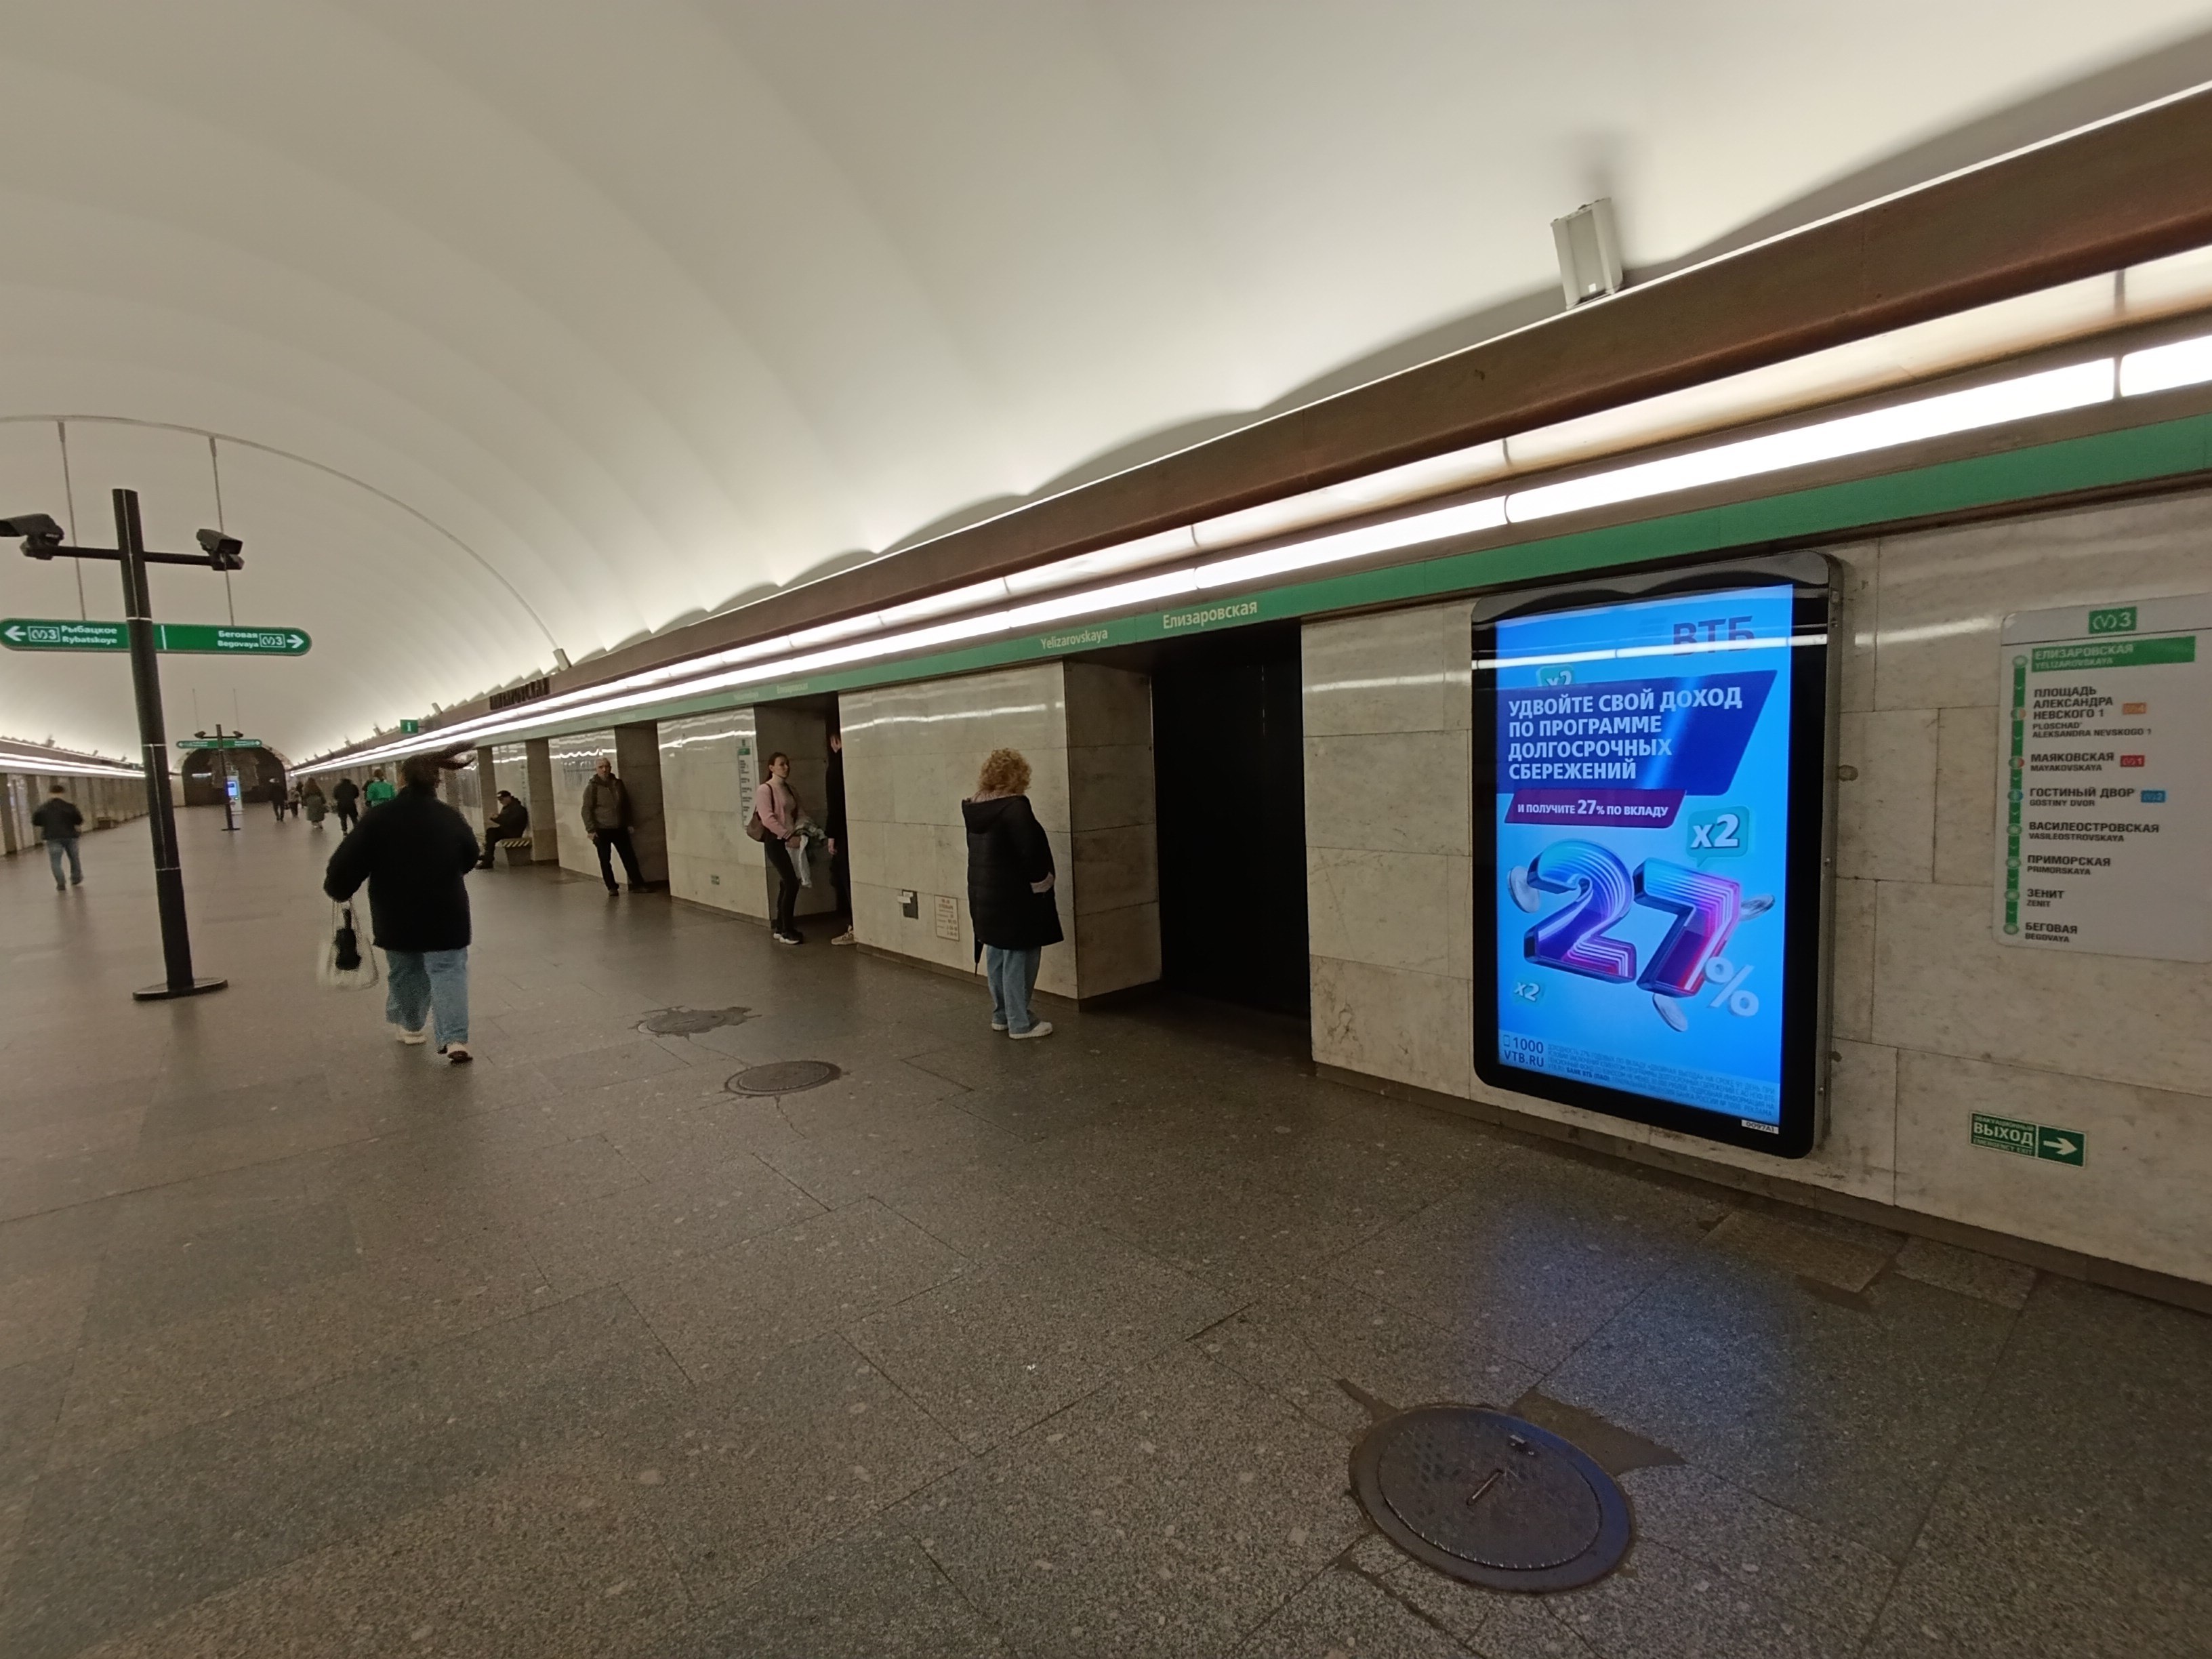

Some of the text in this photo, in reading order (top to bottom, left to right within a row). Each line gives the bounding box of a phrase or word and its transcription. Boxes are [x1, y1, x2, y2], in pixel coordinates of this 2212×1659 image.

[1163, 601, 1258, 630] Елизаровская
[61, 625, 117, 634] Рыбацкое
[218, 630, 258, 638] Беговая
[1671, 615, 1755, 655] ВТБ
[62, 636, 117, 645] Rybatskoye
[217, 640, 259, 649] Begovaya
[1040, 628, 1108, 650] Yelizarovskaya
[2035, 644, 2133, 659] ЕЛИЗАРОВСКАЯ
[2034, 687, 2096, 697] ПЛОЩАДЬ
[1509, 687, 1742, 719] УДВОЙТЕ СВОЙ ДОХОД
[2034, 697, 2113, 709] АЛЕКСАНДРА
[2033, 710, 2094, 720] НЕВСКОГО
[1509, 715, 1662, 738] ПО ПРОГРАММЕ
[2033, 730, 2091, 738] ALEKSANDRA
[2094, 729, 2144, 737] NEVSKOGO
[1508, 739, 1672, 762] ДОЛГОСРОЧНЫХ
[2031, 752, 2114, 762] МАЯКОВСКАЯ
[1509, 758, 1636, 780] СБЕРЕЖЕНИЙ
[2031, 764, 2102, 772] MAYAKOVSKAYA
[2030, 787, 2135, 798] ГОСТИНЫЙ ДВОР
[1517, 800, 1668, 817] И ПОЛУЧИТЕ 27% ПО ВКЛАДУ
[2029, 822, 2159, 833] ВАСИЛЕОСТРОВСКАЯ
[2029, 833, 2125, 842] VASILEOSTROVSKAYA
[2028, 855, 2110, 867] ПРИМОРСКАЯ
[2027, 866, 2091, 875] PRIMORSKAYA
[2027, 888, 2064, 899] ЗЕНИТ
[2026, 899, 2051, 907] ZENIT
[2026, 922, 2077, 934] БЕГОВАЯ
[2025, 933, 2069, 943] BEGOVAYA
[1513, 1037, 1544, 1054] 1000
[1504, 1050, 1544, 1067] VTB.RU
[1973, 1122, 2033, 1146] ВЫХОД
